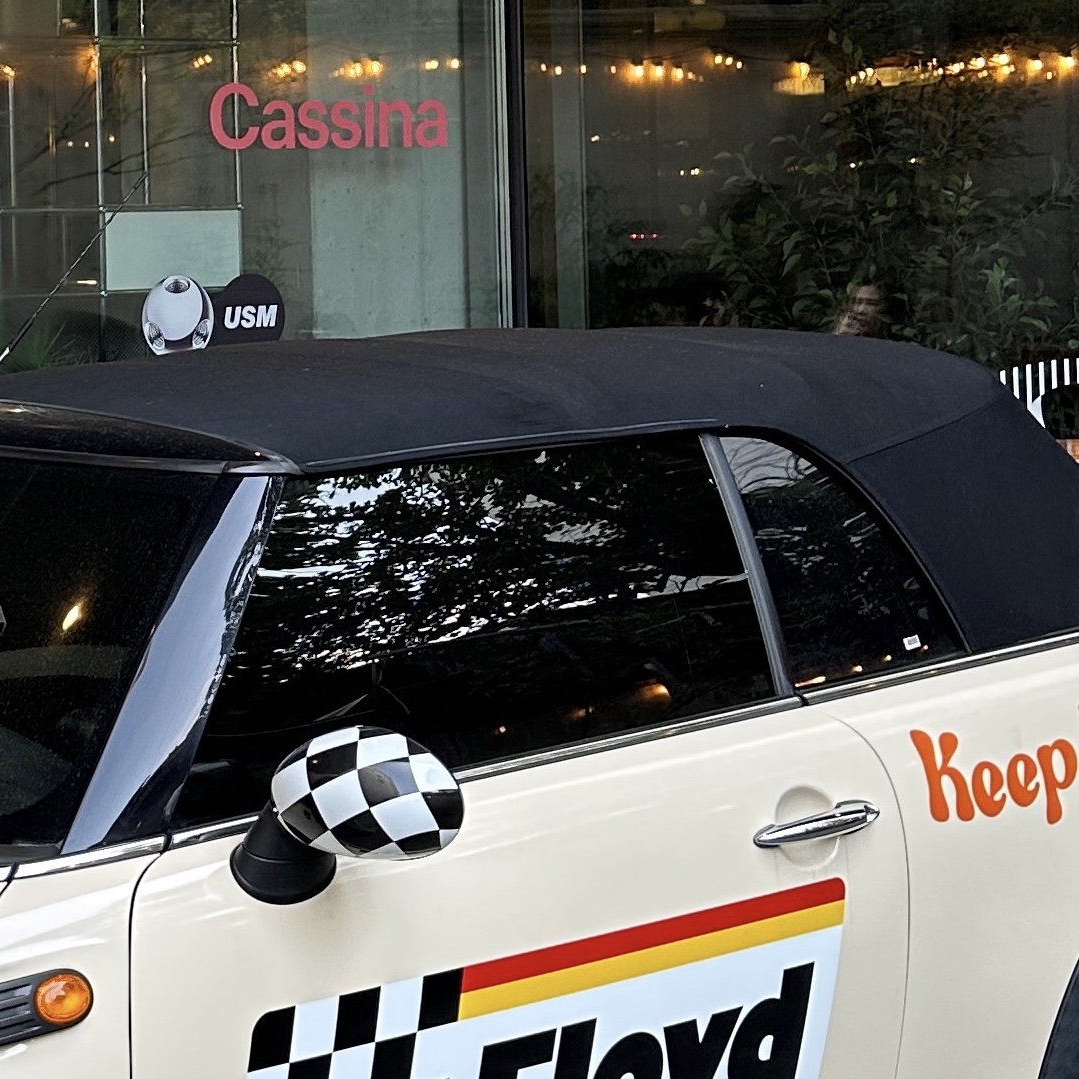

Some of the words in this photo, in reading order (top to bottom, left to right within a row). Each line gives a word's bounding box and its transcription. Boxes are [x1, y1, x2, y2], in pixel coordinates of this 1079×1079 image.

[209, 82, 448, 150] Cassina
[224, 304, 278, 329] USM
[909, 729, 1078, 825] Keep
